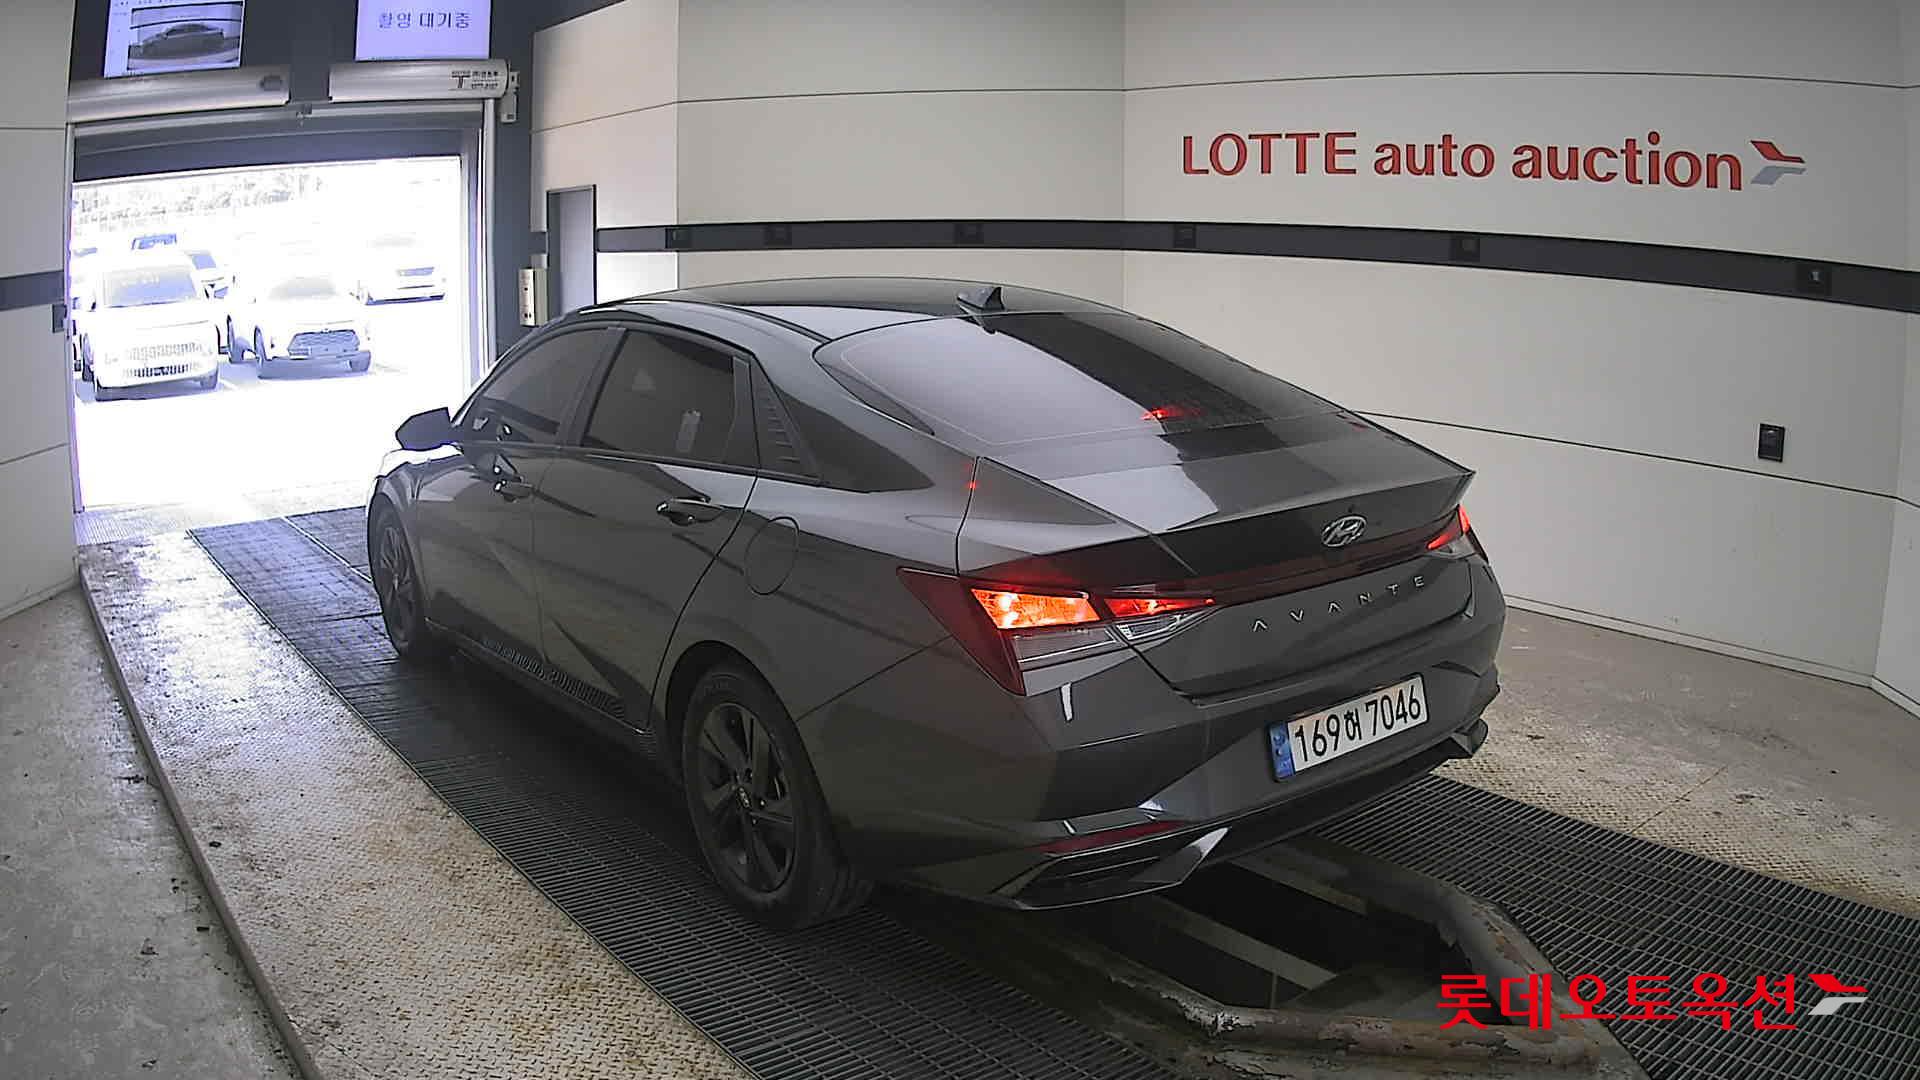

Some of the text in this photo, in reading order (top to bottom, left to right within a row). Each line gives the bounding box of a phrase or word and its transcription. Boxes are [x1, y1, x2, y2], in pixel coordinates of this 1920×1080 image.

[419, 12, 472, 29] 대기중
[1183, 131, 1742, 190] LOTTE auto auction
[1252, 575, 1425, 632] AVANTE
[1294, 685, 1421, 762] 169허 7046
